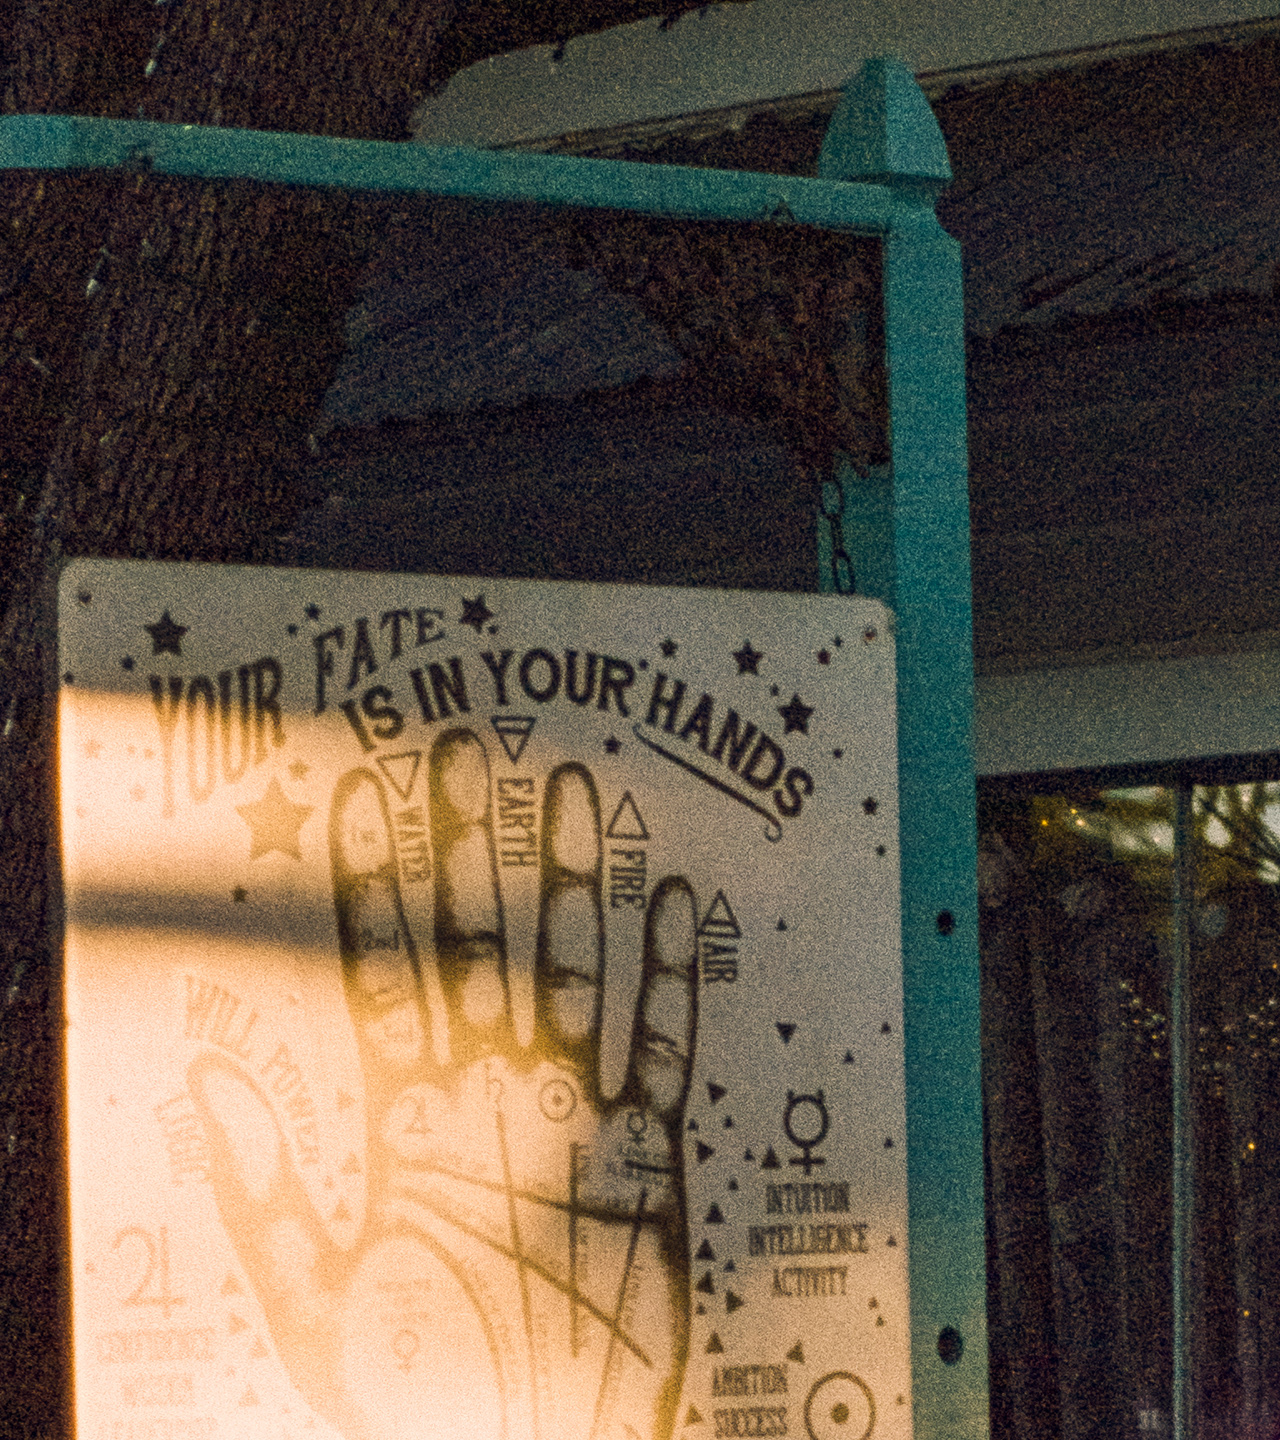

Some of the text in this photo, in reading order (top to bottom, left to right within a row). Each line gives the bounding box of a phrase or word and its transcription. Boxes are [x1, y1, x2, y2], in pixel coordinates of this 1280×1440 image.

[150, 607, 446, 818] YOUR FATE
[340, 647, 816, 821] IS IN YOUR HANDS
[395, 805, 434, 885] WATER
[498, 775, 538, 868] EARTH
[609, 846, 648, 912] FIRE
[704, 939, 740, 986] AIR
[184, 974, 320, 1168] WILL POWER
[766, 1181, 850, 1213] INTUITION
[748, 1223, 868, 1256] INTELLIGENCE
[772, 1266, 847, 1297] ACTIVITY
[712, 1364, 788, 1397] AMBITION
[714, 1407, 788, 1438] SUCCESS
